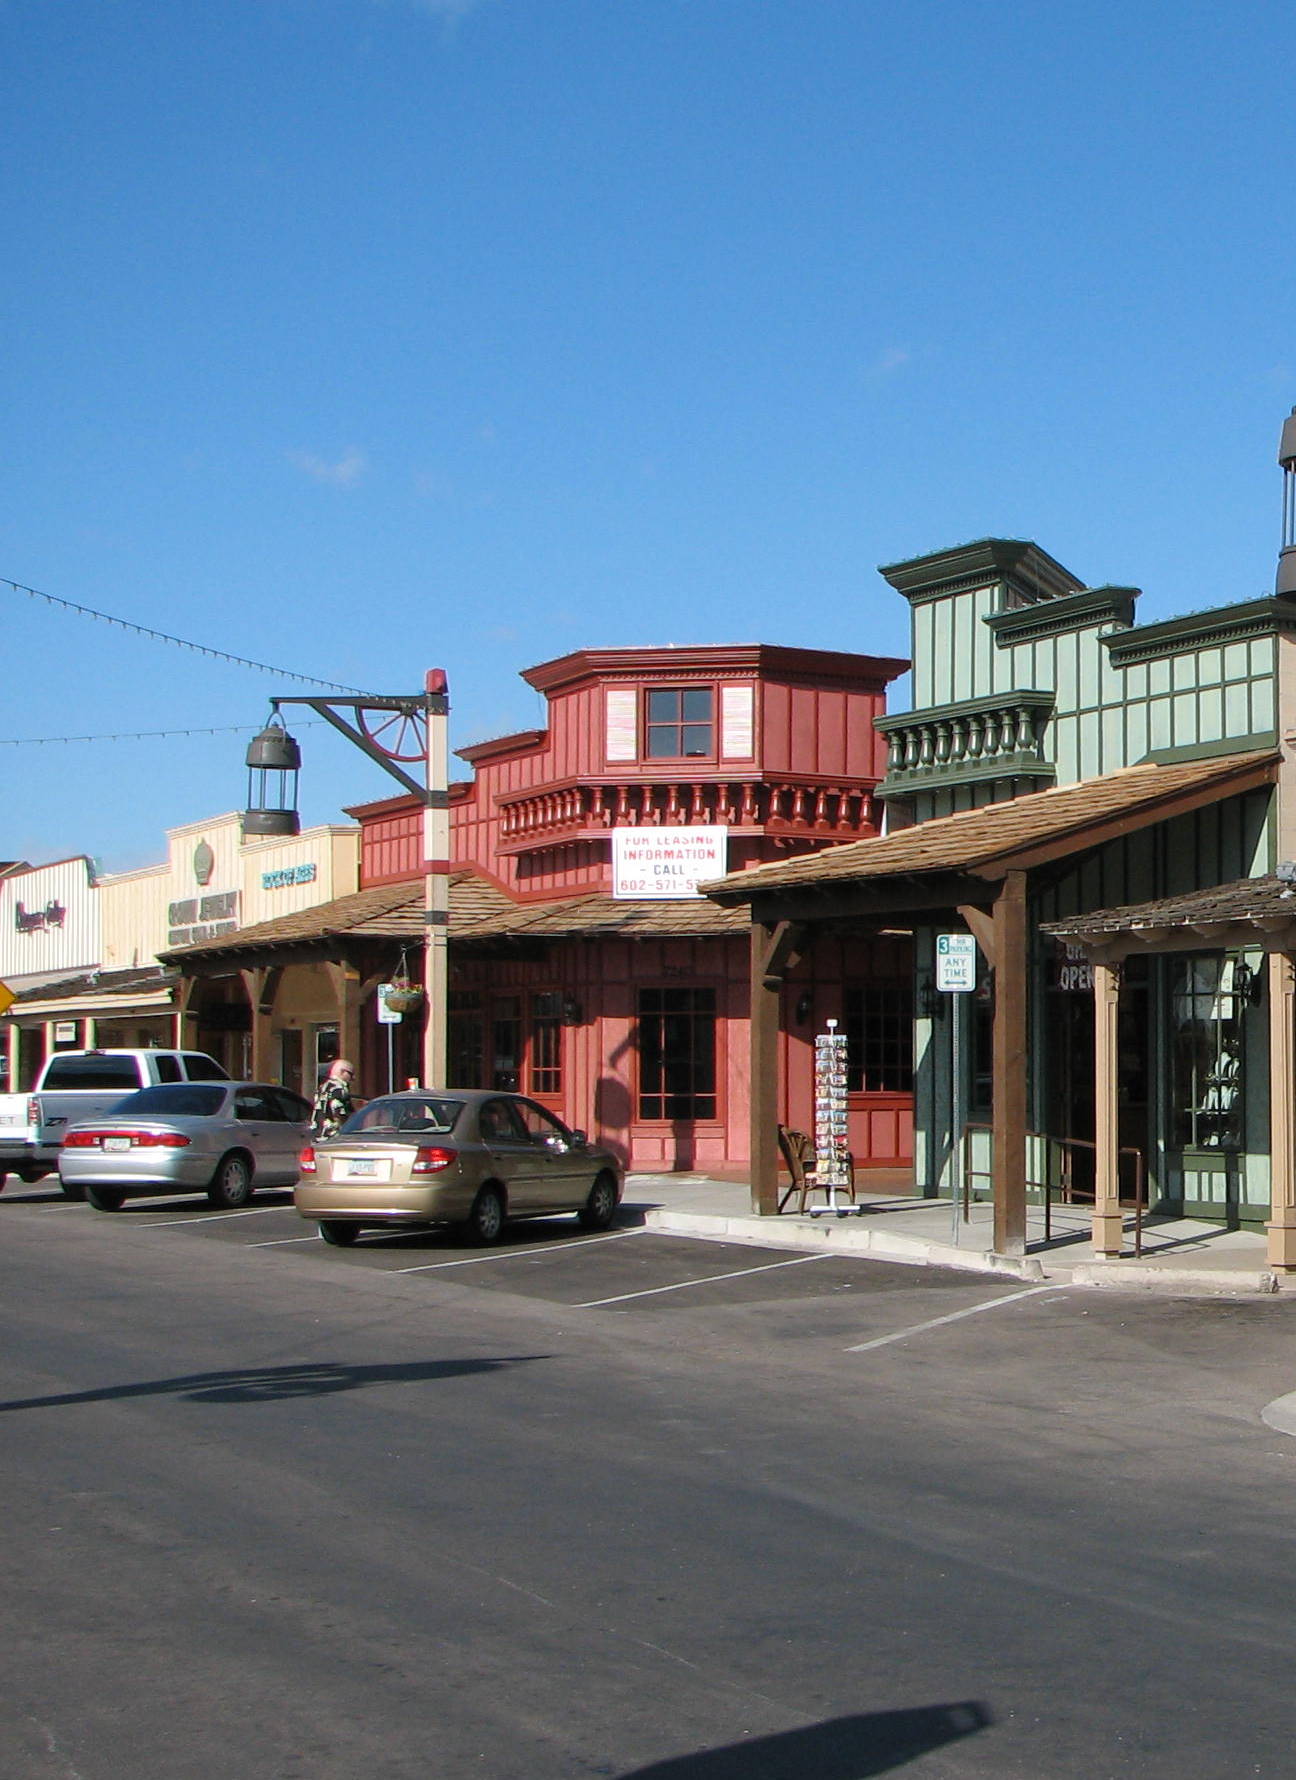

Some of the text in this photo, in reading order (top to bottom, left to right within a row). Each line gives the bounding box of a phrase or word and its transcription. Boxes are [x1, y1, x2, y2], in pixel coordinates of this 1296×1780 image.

[624, 848, 716, 861] INFORMATION
[653, 864, 686, 876] CALL
[620, 879, 700, 891] 602-571-5
[939, 938, 949, 953] 3
[945, 958, 967, 967] ANY
[944, 968, 967, 978] TIME
